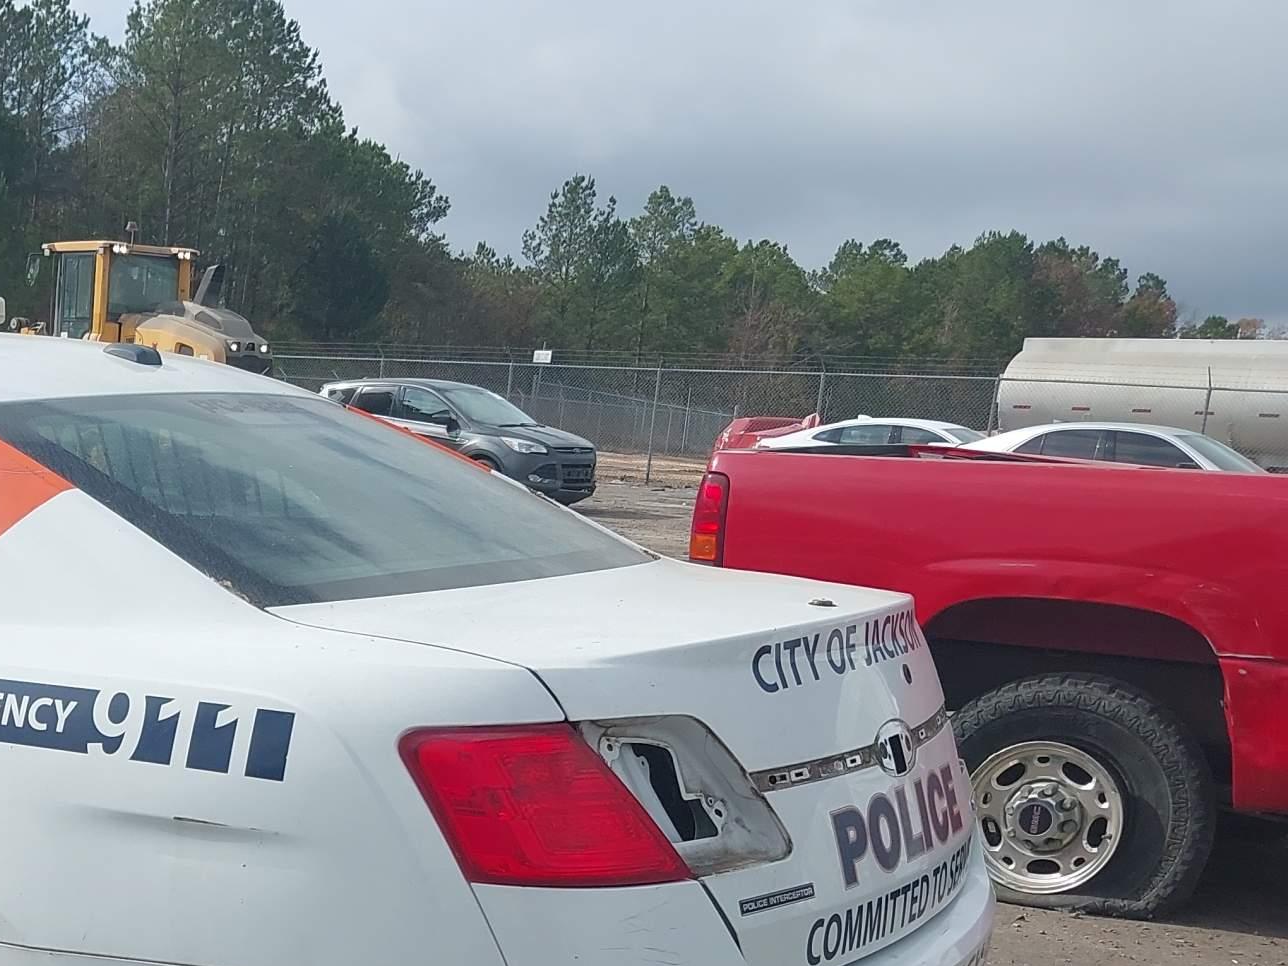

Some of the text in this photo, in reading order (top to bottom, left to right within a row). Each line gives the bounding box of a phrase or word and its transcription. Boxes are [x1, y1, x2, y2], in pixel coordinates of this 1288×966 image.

[751, 609, 922, 693] CITY OF JACKSON
[92, 687, 255, 776] 911
[829, 764, 963, 891] POLICE
[742, 886, 813, 912] POLICE INTERCEPTOR
[806, 873, 930, 966] COMMITTED
[931, 861, 948, 908] TO
[947, 834, 972, 897] SERV
